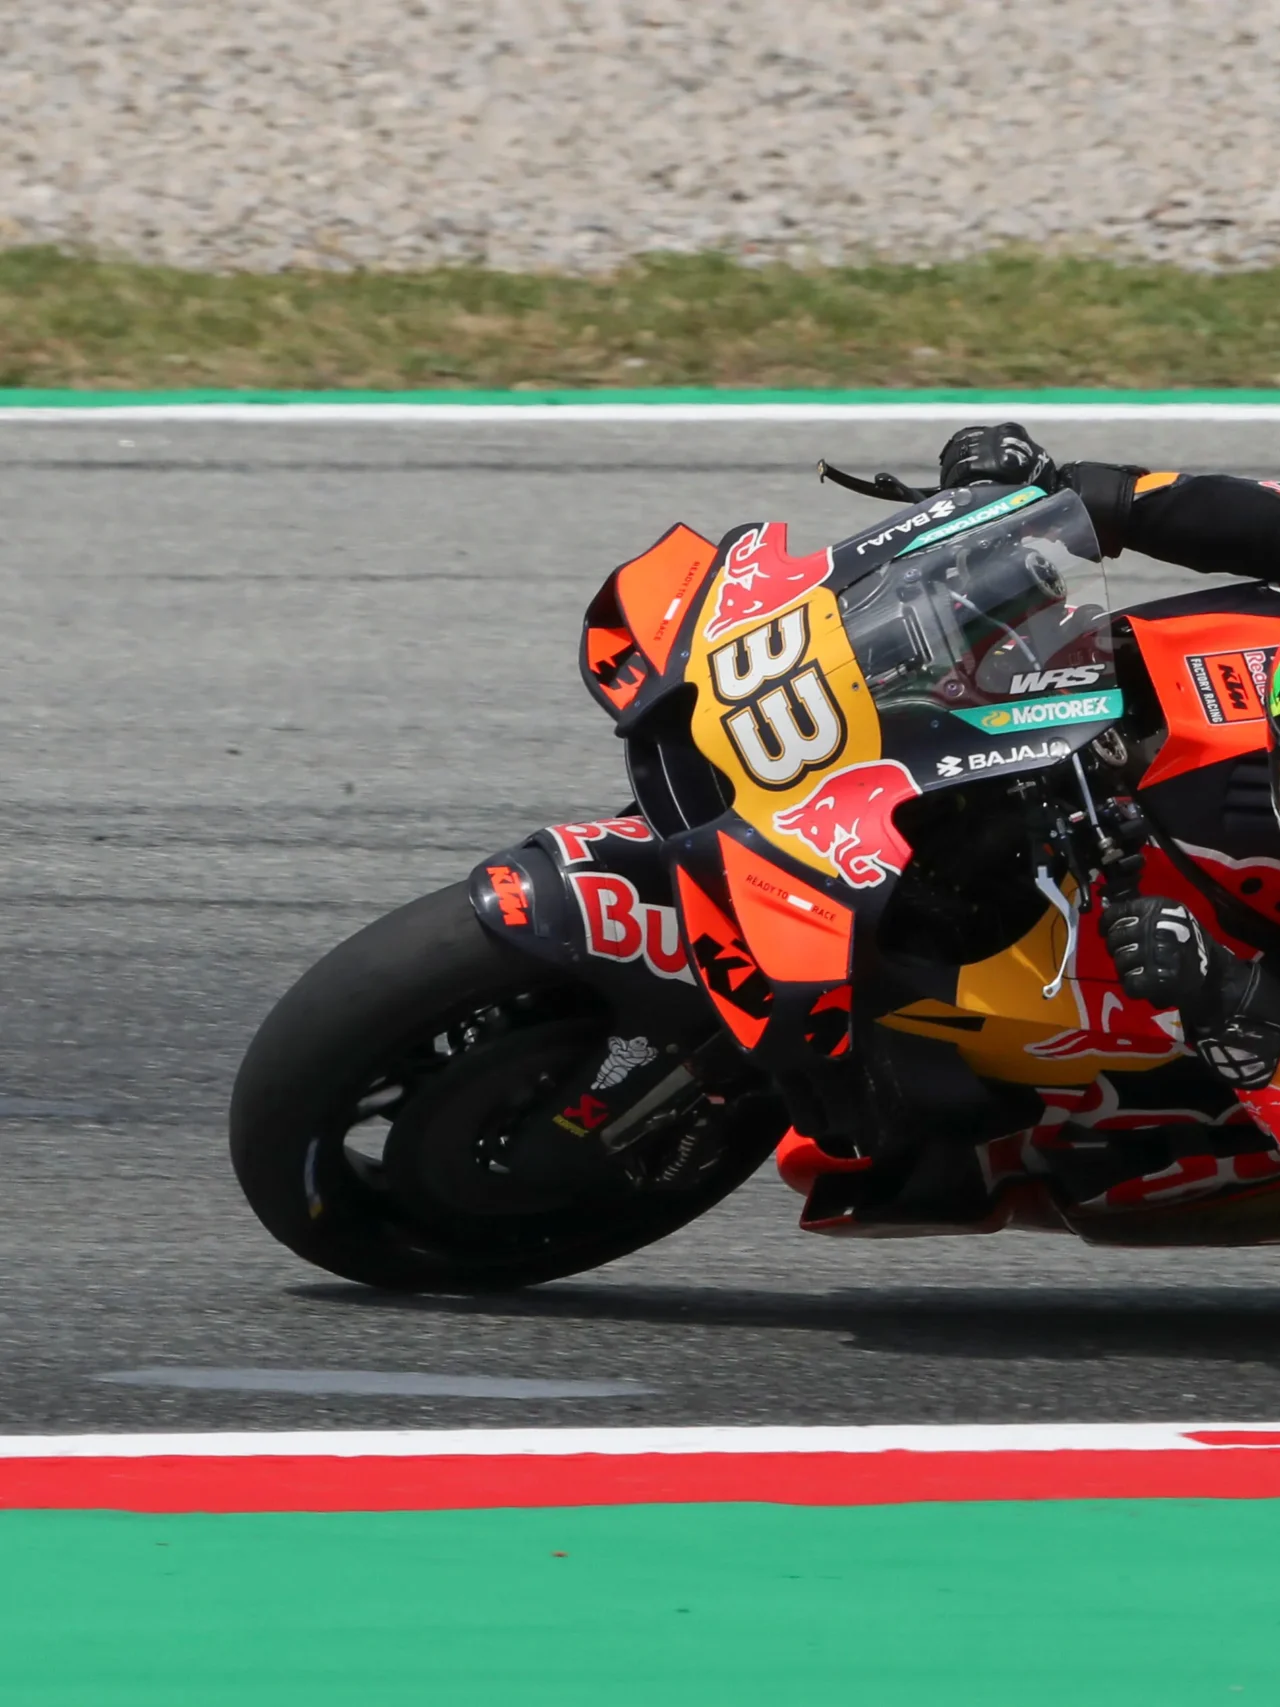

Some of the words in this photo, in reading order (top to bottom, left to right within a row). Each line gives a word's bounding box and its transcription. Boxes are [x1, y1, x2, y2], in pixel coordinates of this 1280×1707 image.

[855, 512, 931, 556] BAJAJ
[931, 502, 1012, 544] MOTOREX
[674, 587, 686, 600] TO
[682, 560, 700, 588] READY
[653, 619, 669, 643] RACE
[708, 603, 848, 791] 33
[1010, 664, 1105, 695] WRS
[1190, 658, 1212, 691] FACTORY
[1203, 692, 1223, 723] RACING
[1218, 663, 1248, 710] KTM
[1012, 697, 1112, 725] MOTOREX
[968, 745, 1049, 771] BAJAJ
[549, 815, 656, 866] ed
[487, 864, 528, 927] KTM
[745, 873, 776, 897] READY
[775, 888, 789, 901] TO
[811, 904, 838, 923] RACE
[569, 870, 698, 987] Bu
